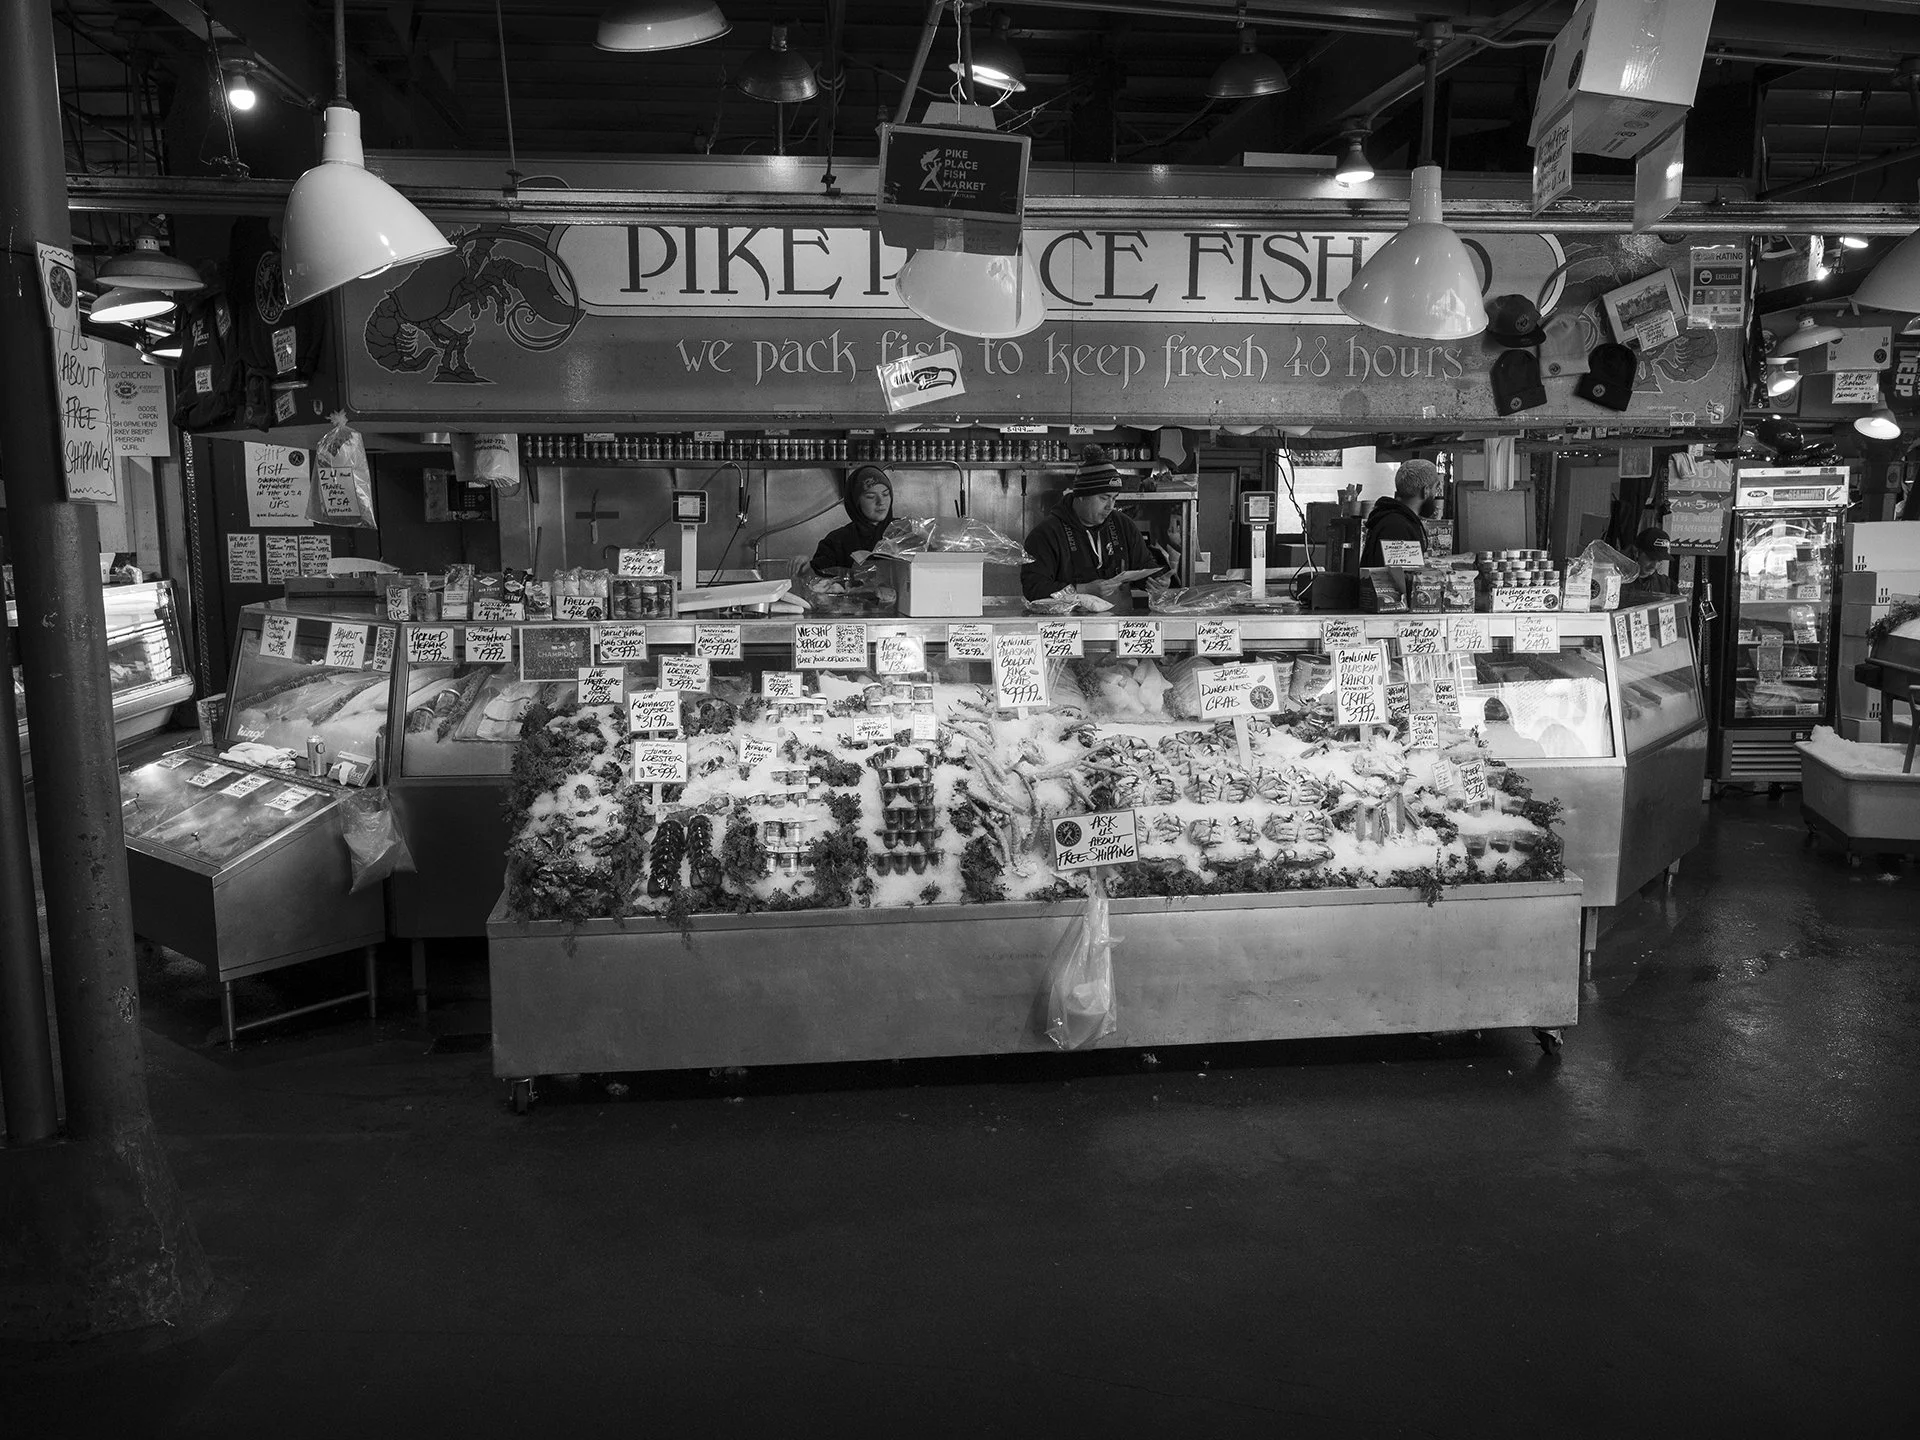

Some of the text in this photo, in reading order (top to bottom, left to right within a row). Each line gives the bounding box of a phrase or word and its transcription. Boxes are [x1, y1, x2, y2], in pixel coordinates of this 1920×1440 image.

[945, 149, 968, 159] PIKE
[944, 160, 978, 171] PLACE
[943, 170, 966, 180] FISH
[942, 180, 986, 191] MARKET
[1716, 251, 1744, 262] RATING
[619, 225, 843, 301] PIKE
[862, 228, 1159, 306] PCE
[1181, 231, 1370, 304] FISH
[676, 338, 734, 374] we
[752, 329, 858, 386] pack
[978, 336, 1024, 376] to
[1043, 331, 1146, 390] keep
[1161, 333, 1269, 389] fresh
[1283, 335, 1332, 379] 48
[1345, 333, 1464, 382] hours
[62, 352, 102, 389] ABOUT
[120, 371, 152, 379] CHICKEN
[64, 396, 100, 431] FREE
[65, 440, 110, 474] SHIPPING
[256, 462, 289, 476] FISH
[269, 500, 290, 509] UPS
[328, 497, 350, 506] TSA
[797, 625, 832, 637] WE SHIP
[1138, 628, 1156, 638] COD
[1424, 627, 1439, 637] COD
[796, 638, 832, 649] SEAFOOD
[1337, 650, 1379, 663] GENUINE
[1214, 667, 1248, 678] JUMBO
[1339, 662, 1379, 674] ALASKAN
[1205, 696, 1240, 711] CRAB
[1341, 691, 1374, 707] CRAB
[641, 754, 684, 763] LOBSTER
[1090, 815, 1118, 830] ASK
[1098, 827, 1113, 836] US
[1088, 833, 1133, 848] ABOUT
[1057, 849, 1090, 867] FREE
[1087, 844, 1134, 862] SHIPPING
